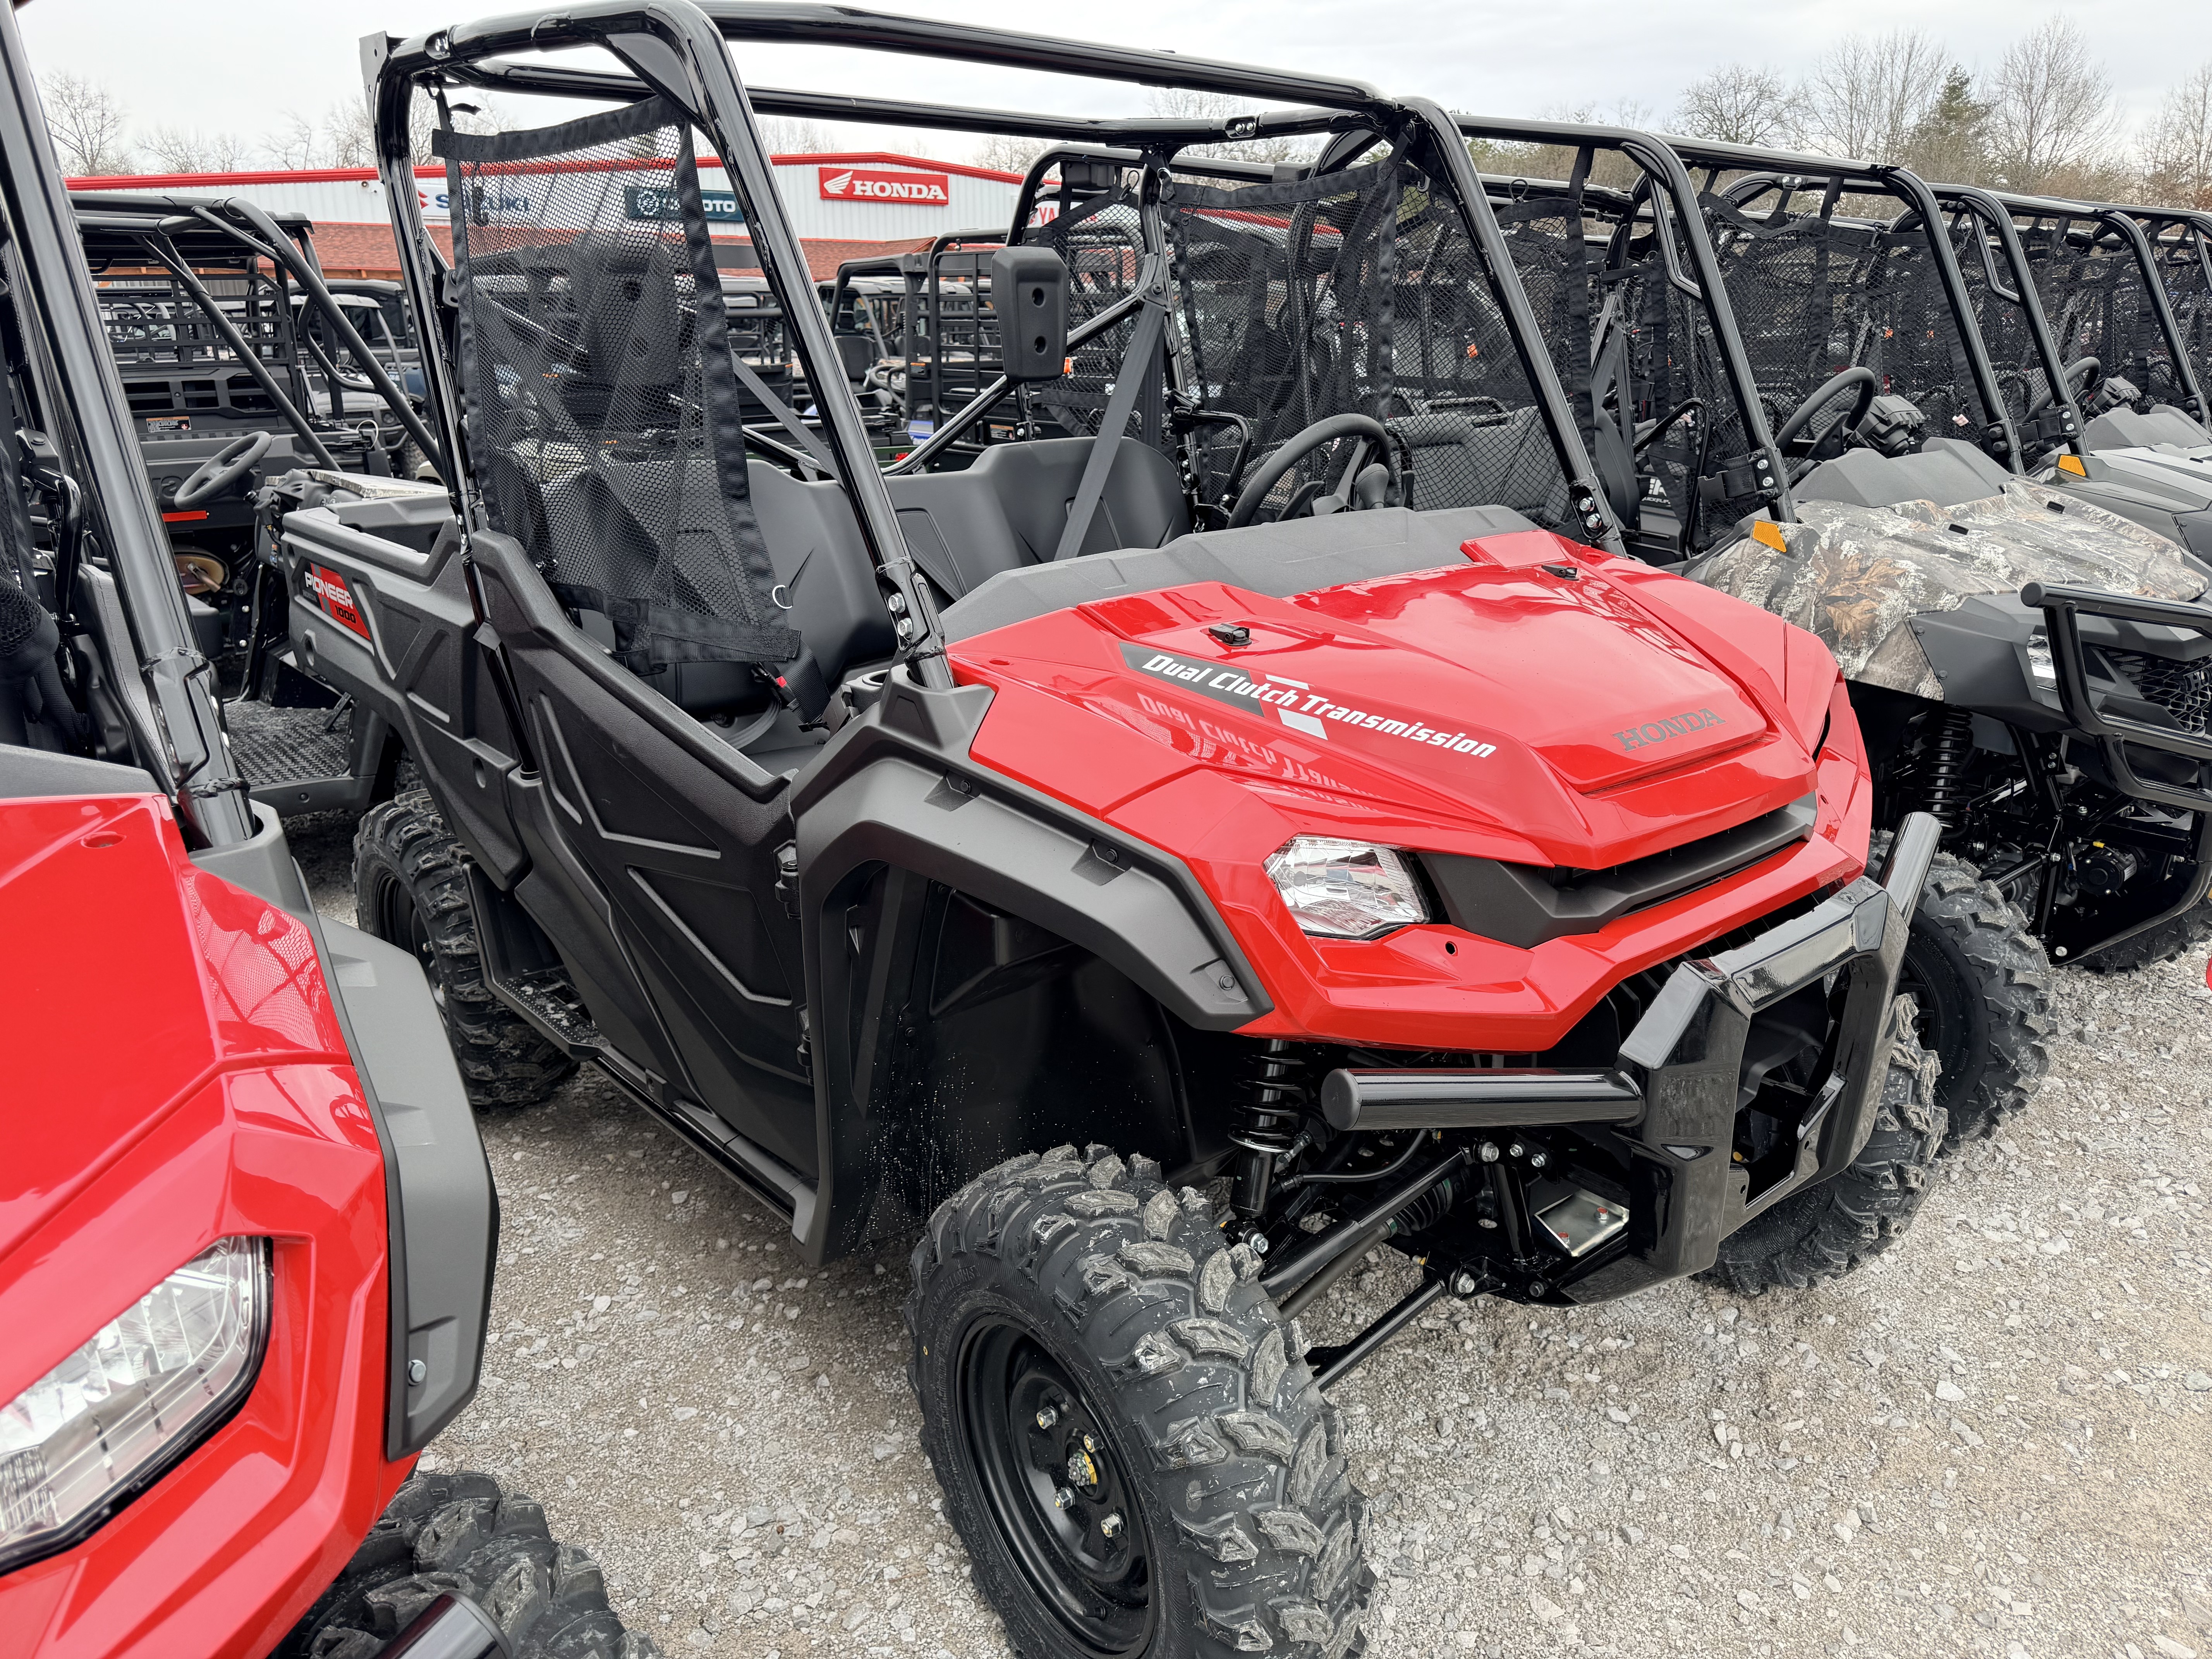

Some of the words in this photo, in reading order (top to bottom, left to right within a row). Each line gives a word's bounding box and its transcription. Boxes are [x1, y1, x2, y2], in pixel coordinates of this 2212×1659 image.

[852, 180, 947, 200] HONDA
[304, 571, 354, 610] PIONEER
[335, 605, 356, 624] 1000
[1142, 654, 1213, 683] Dual
[1208, 672, 1299, 706] Clutch
[1299, 694, 1497, 758] Transmission
[1612, 708, 1726, 751] HONDA
